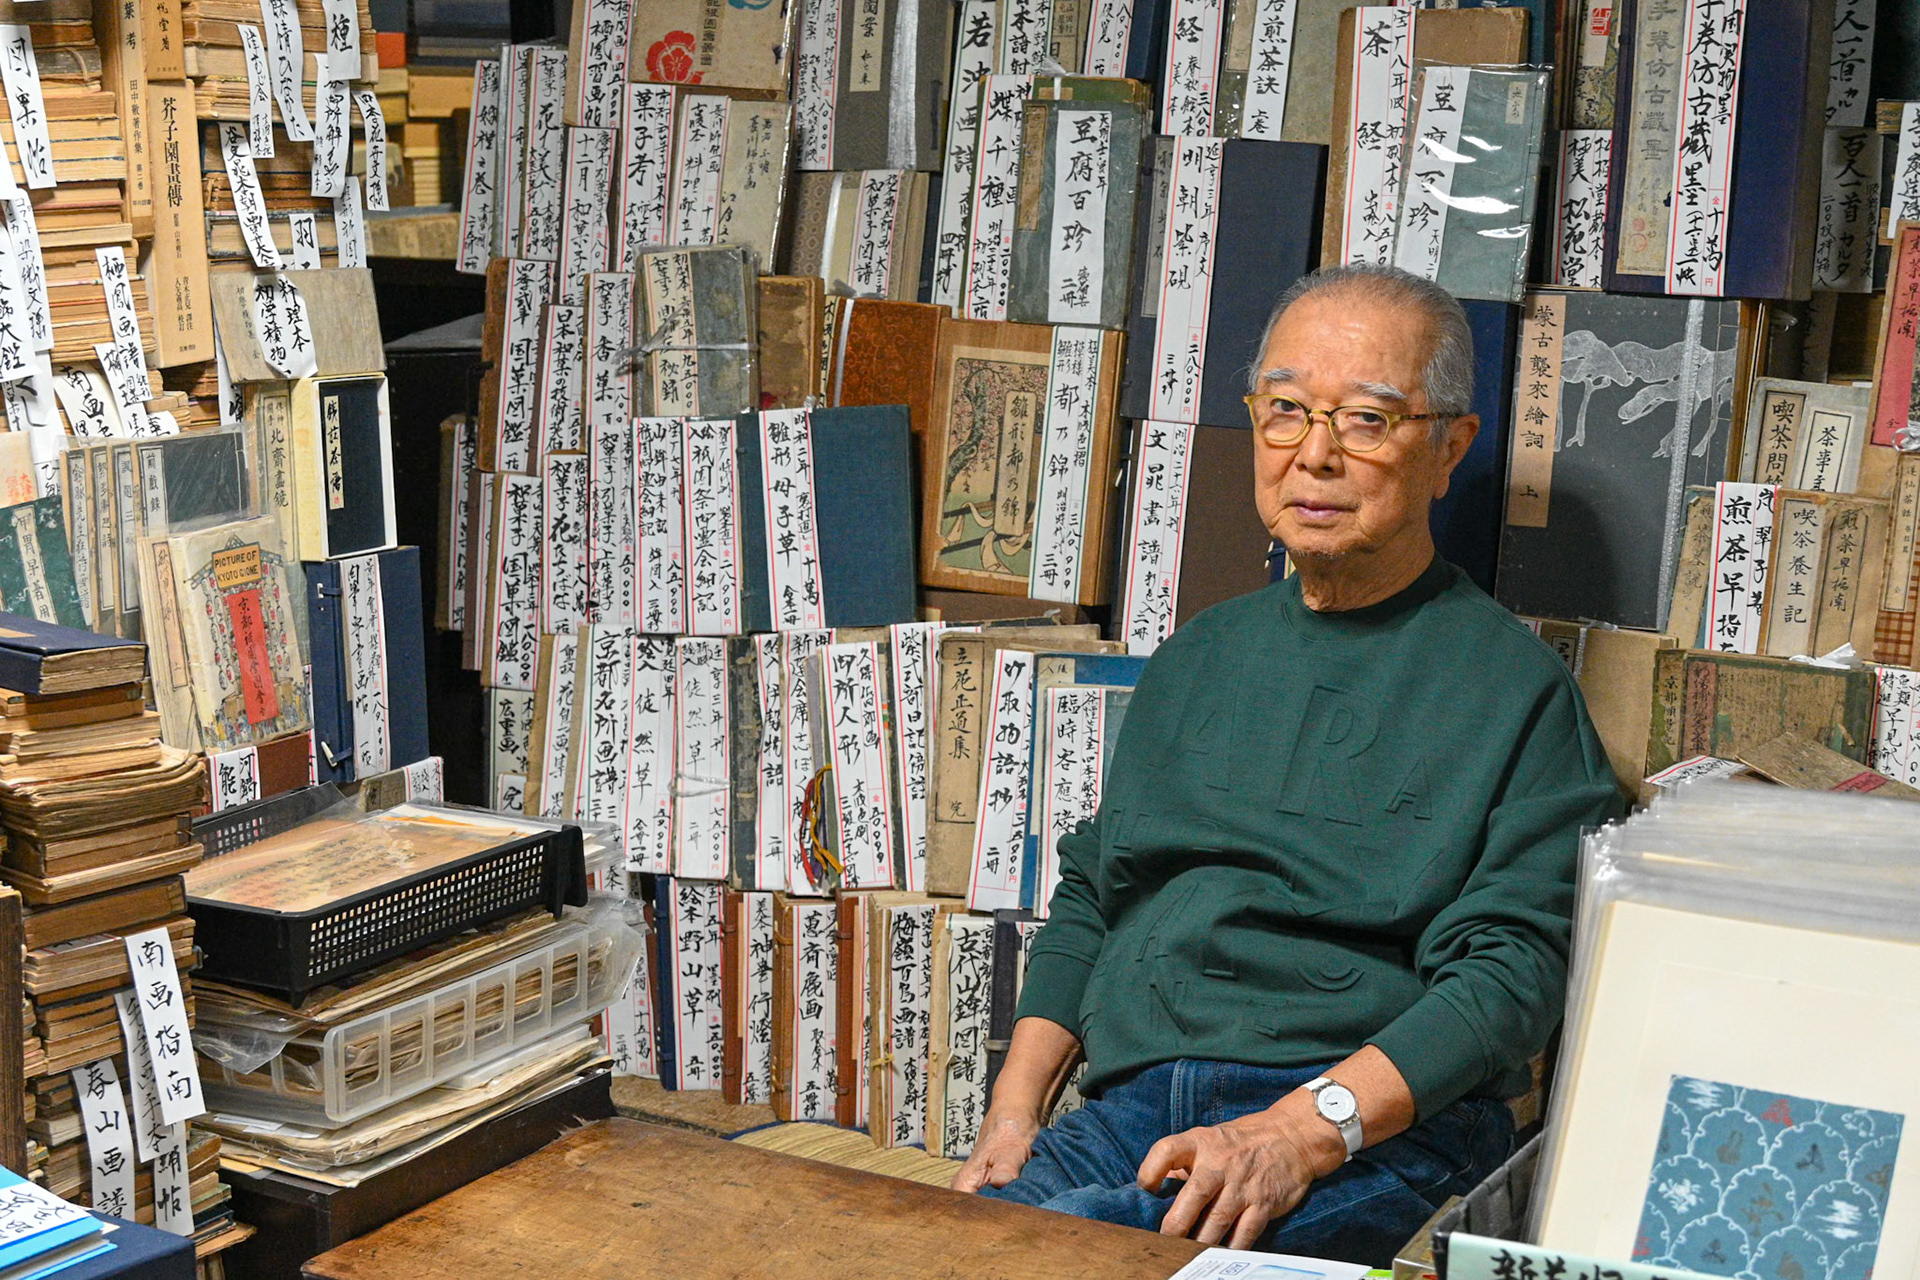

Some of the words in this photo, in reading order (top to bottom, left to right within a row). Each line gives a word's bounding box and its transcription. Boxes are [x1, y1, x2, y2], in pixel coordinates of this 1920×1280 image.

[1825, 0, 1870, 124] 人一首カルタ
[161, 97, 184, 208] 芥子園畫傳
[628, 89, 655, 187] 菓子考
[1062, 115, 1098, 254] 豆腐百珍
[854, 178, 884, 286] 和菓子図譜
[1165, 145, 1202, 290] 明朝紫硯
[278, 278, 310, 353] 料理本
[1046, 381, 1080, 480] 都乃錦
[1519, 305, 1558, 450] 蒙古襲來繪詞
[767, 421, 800, 568] 雛形母子草
[1000, 395, 1030, 527] 雛形都乃錦
[1137, 428, 1169, 566] 文晁畫譜
[1518, 484, 1539, 499] 上
[215, 554, 246, 568] PICTURE
[247, 551, 258, 561] OF
[217, 570, 239, 582] KYOTO
[1783, 509, 1819, 624] 喫茶養生記
[1829, 507, 1863, 613] 煎茶早指南
[590, 629, 623, 796] 京都名所画譜
[632, 687, 660, 805] 徒然草
[683, 677, 706, 776] 徒然草
[761, 683, 783, 788] 伊勢物語
[832, 653, 861, 766] 御所人形
[947, 646, 978, 760] 立花正道集
[987, 660, 1028, 815] 竹取物語抄
[502, 786, 523, 811] 完
[949, 800, 967, 818] 完
[981, 845, 1001, 876] 二冊
[677, 886, 705, 1030] 絵本野山草
[949, 926, 984, 1083] 古代山鉾図譜
[137, 940, 194, 1102] 南画指南
